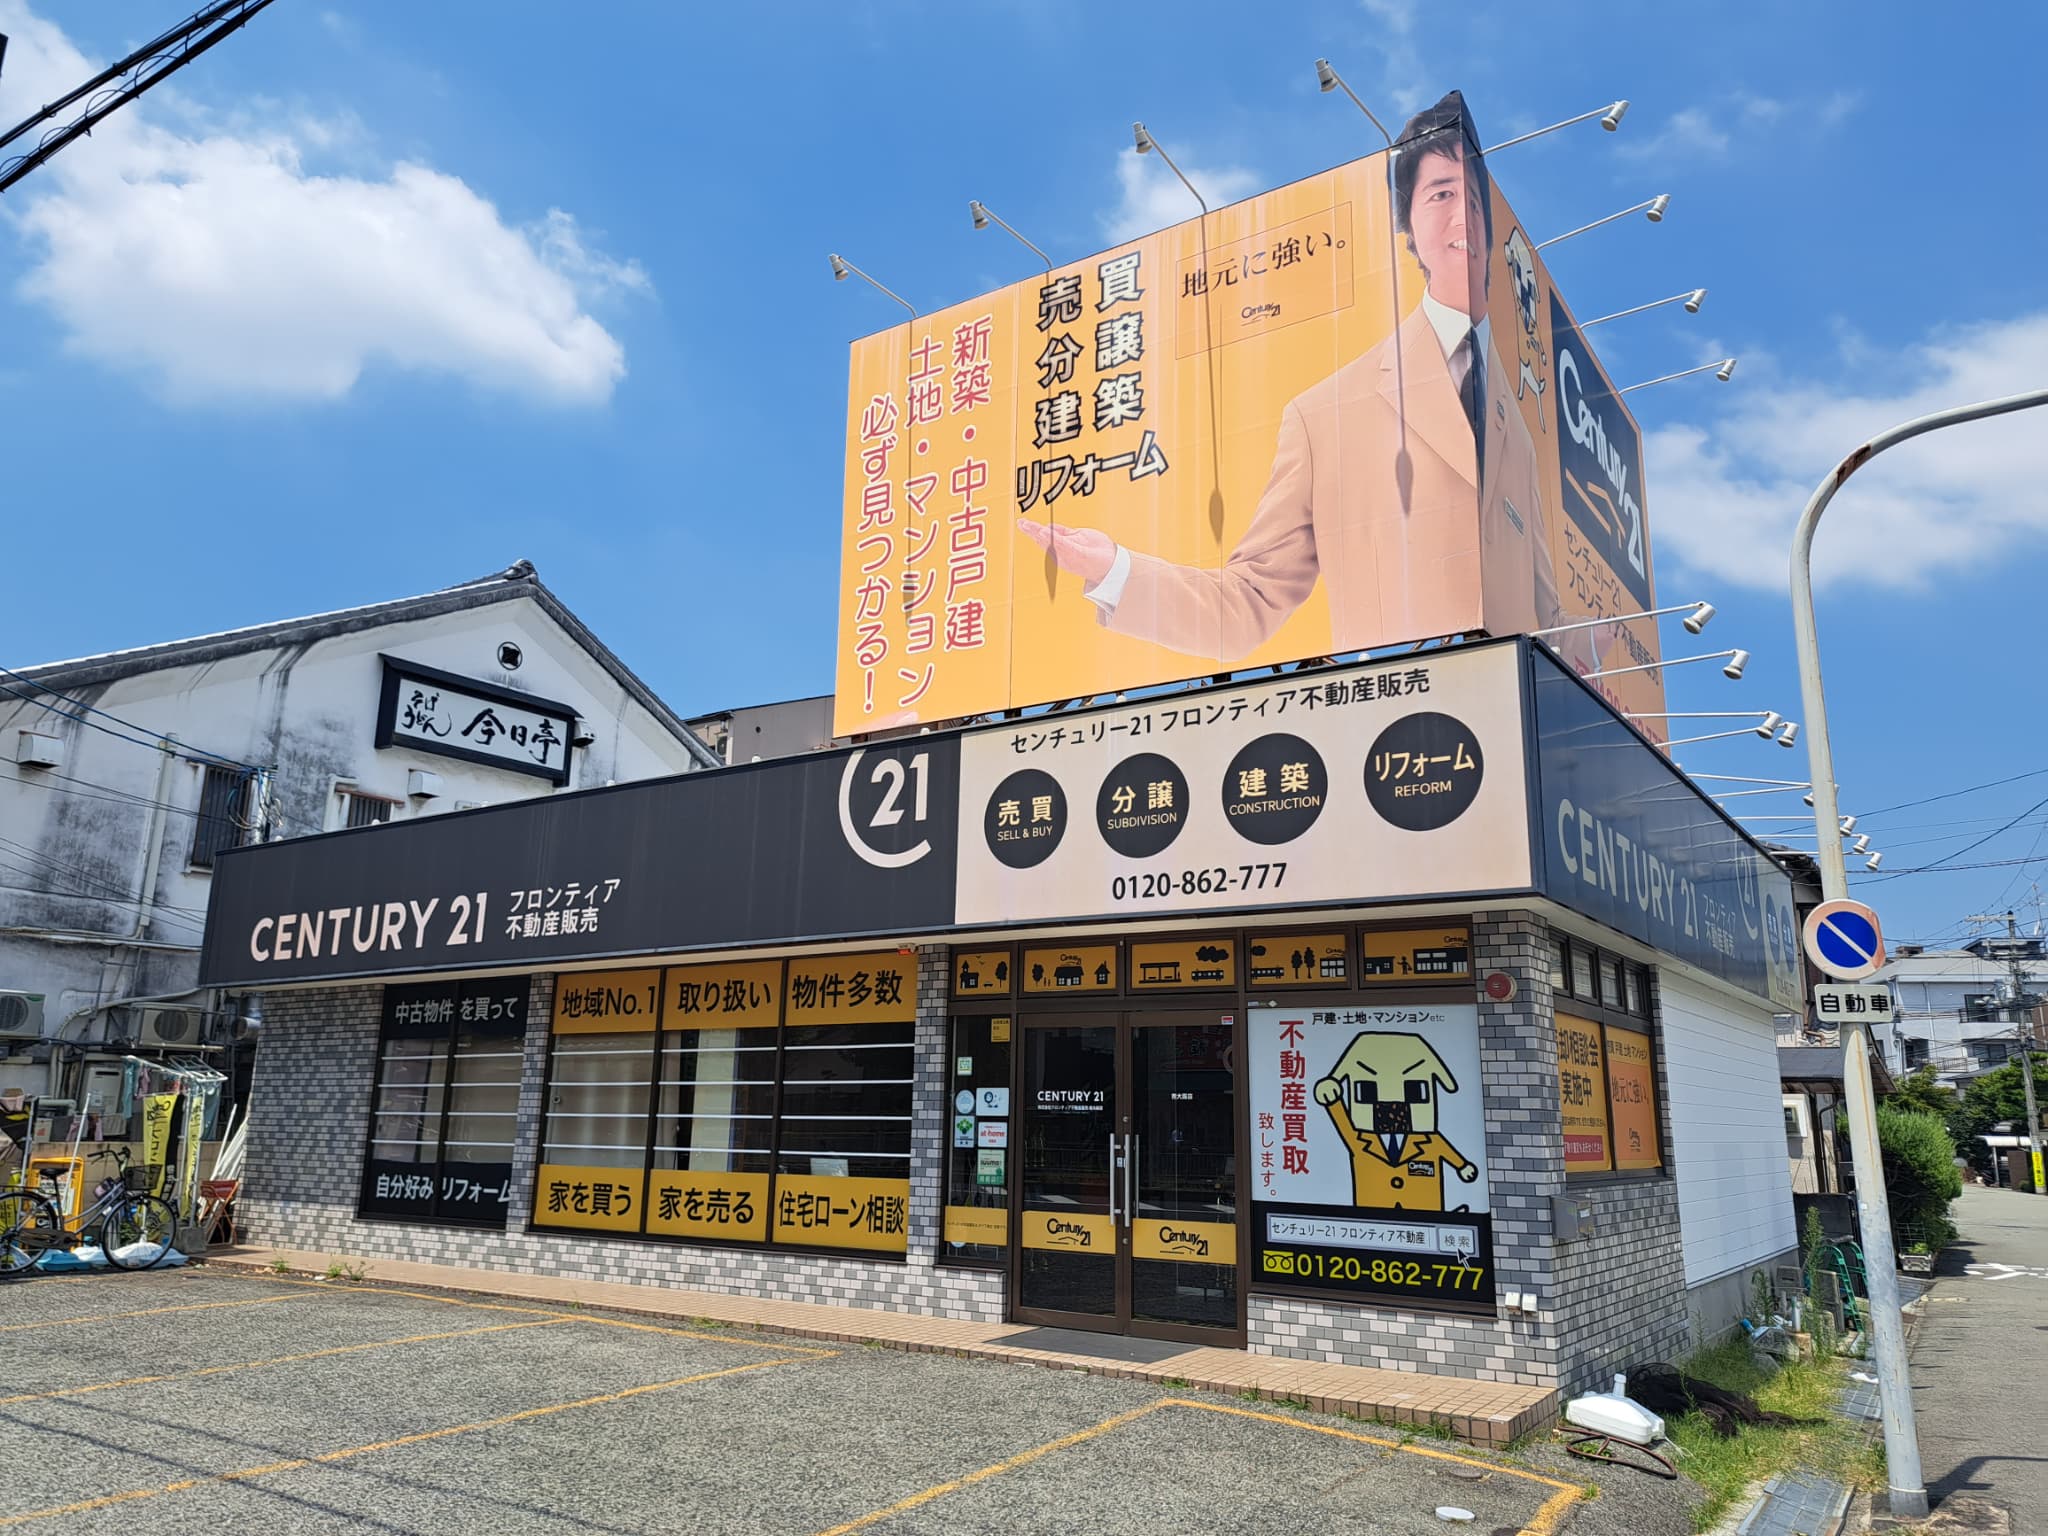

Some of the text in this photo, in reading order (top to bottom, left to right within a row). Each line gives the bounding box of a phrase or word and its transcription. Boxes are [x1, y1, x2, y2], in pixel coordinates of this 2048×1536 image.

[1182, 230, 1346, 299] 地元に強い。
[944, 313, 992, 652] 新築・中古戸建
[1016, 430, 1168, 513] リフォーム
[1559, 348, 1646, 582] Century 21
[898, 336, 944, 707] 土地・マンション
[1563, 523, 1622, 611] センチュリー21
[1010, 668, 1431, 755] センチュリー21 フロンティア不動産販売
[461, 707, 562, 765] 今日亭
[1239, 762, 1310, 799] 建築
[1375, 742, 1476, 782] リフォーム
[1111, 780, 1174, 815] 分譲
[1229, 795, 1321, 817] CONSTRUCTION
[1394, 780, 1453, 799] REFORM
[997, 795, 1053, 828] 売買
[1107, 811, 1178, 831] SUBDIVISION
[997, 825, 1053, 842] SELL & BUY
[1112, 862, 1288, 901] 0120-862-777
[1558, 799, 1700, 941] CENTURY 21
[509, 878, 622, 913] フロンティア
[250, 892, 489, 962] CENTURY 21
[505, 906, 601, 940] 不動産販売
[561, 986, 657, 1018] 地域No.1
[677, 980, 772, 1013] 取り扱い
[791, 970, 903, 1009] 物件多数
[1820, 993, 1889, 1013] 自動車
[395, 998, 518, 1024] 中古物件 を買って
[1037, 1090, 1104, 1102] CENTURY 21
[1279, 1020, 1310, 1175] 不動産買取
[1561, 1070, 1592, 1108] 実施中
[1258, 1112, 1277, 1196] 致します。
[376, 1173, 512, 1203] 自分好み リフォーム
[548, 1180, 633, 1217] 家を買う
[658, 1186, 755, 1225] 家を売る
[778, 1189, 905, 1235] 住宅ローン相談
[1046, 1218, 1091, 1246] Century 21
[1159, 1226, 1208, 1256] Century 21
[1272, 1222, 1471, 1248] センチュリー21 フロンティア不動産 検索
[1297, 1253, 1484, 1291] 0120-862-777
